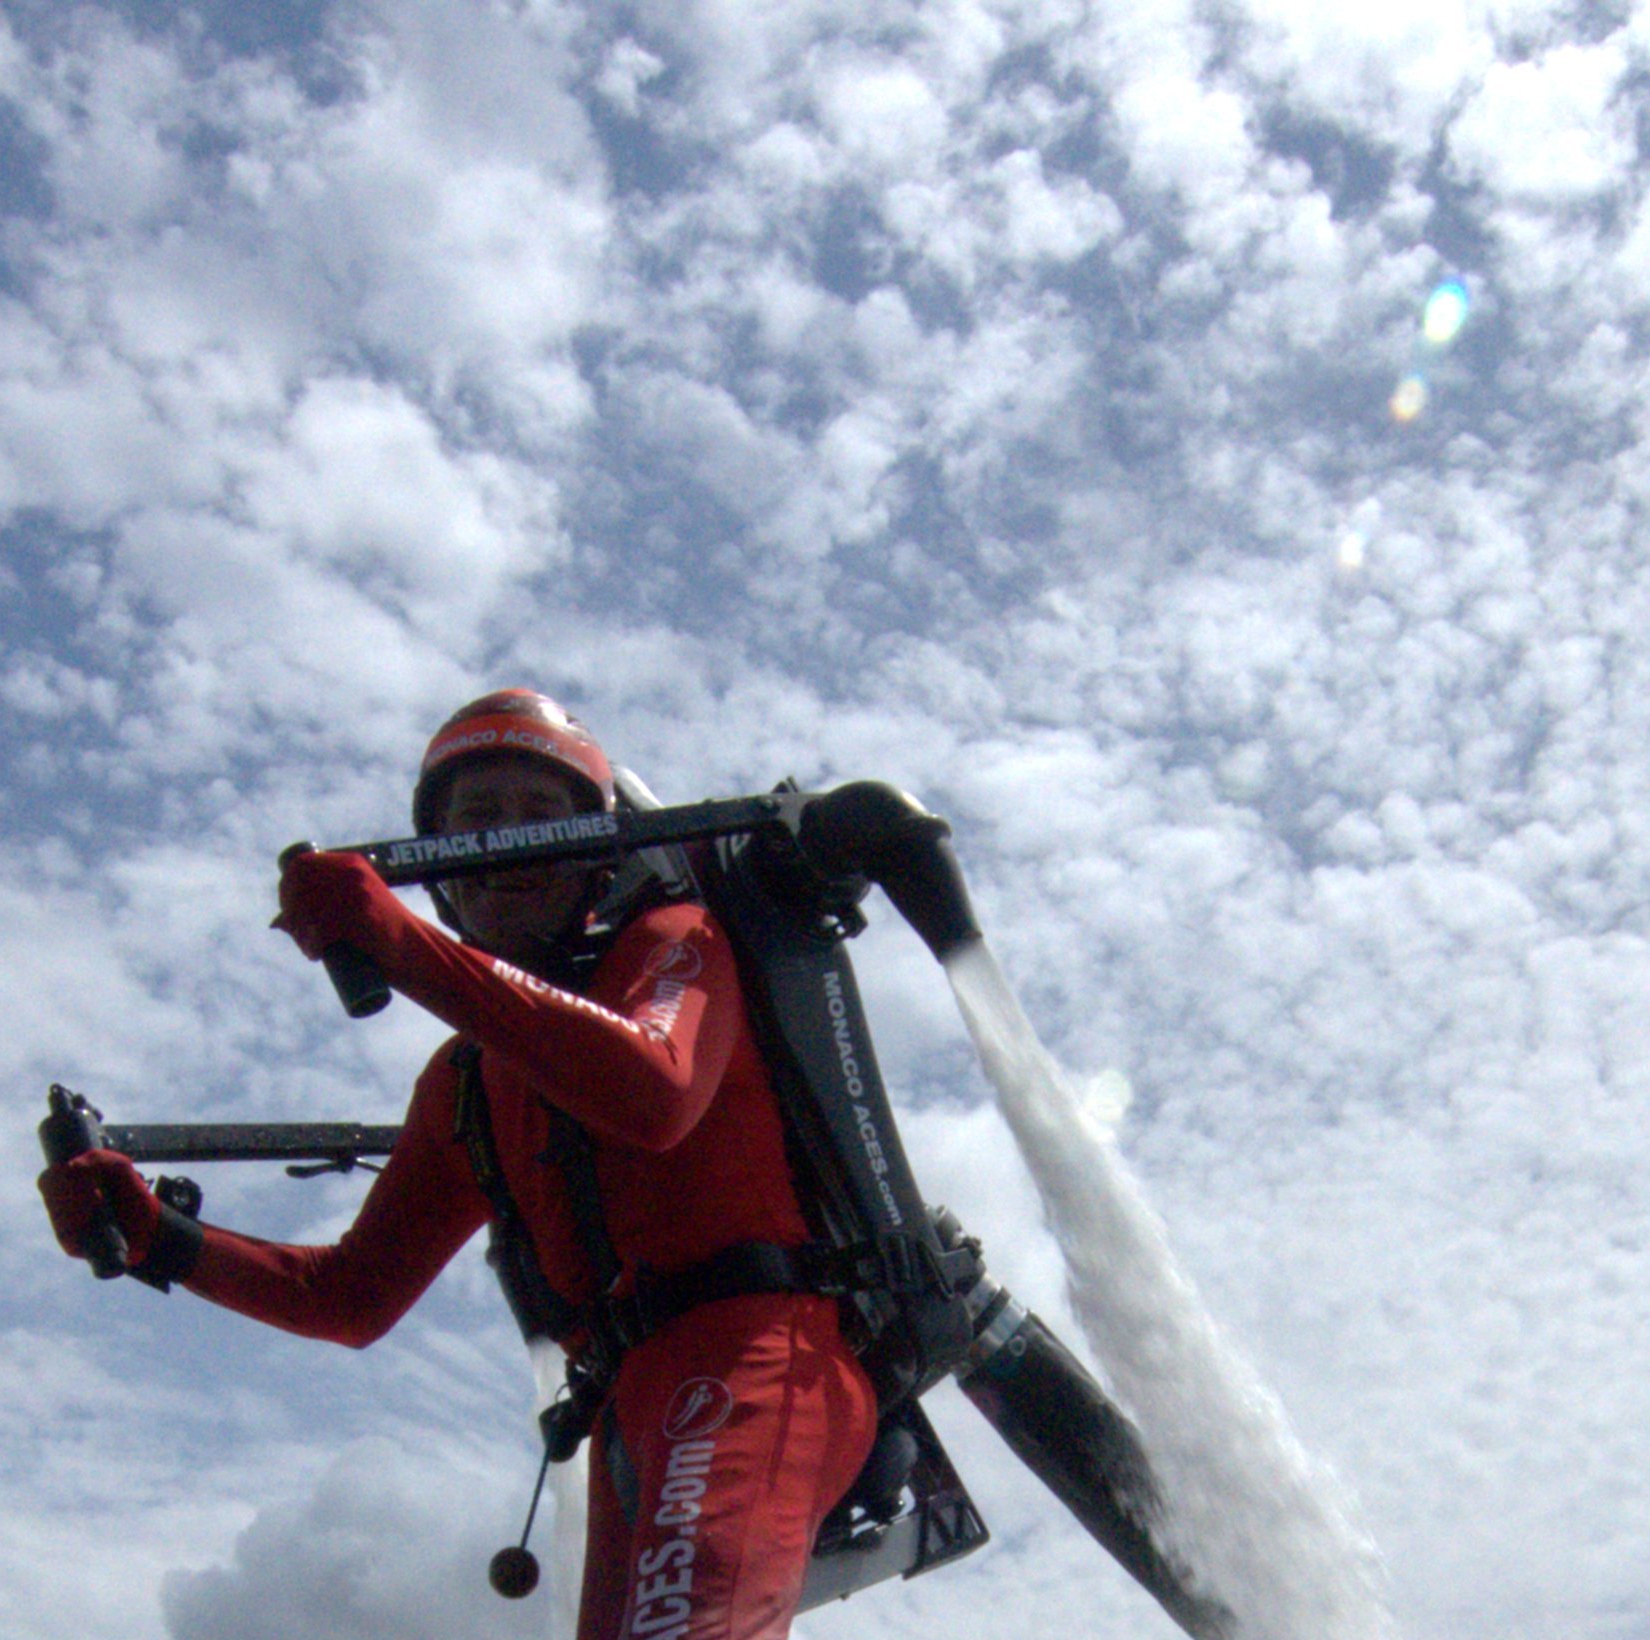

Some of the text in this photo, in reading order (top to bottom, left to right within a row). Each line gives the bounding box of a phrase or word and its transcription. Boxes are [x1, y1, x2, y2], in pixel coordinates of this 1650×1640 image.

[387, 813, 619, 869] JETPACK ADVENTURES
[823, 971, 903, 1226] MONACO ACES.com
